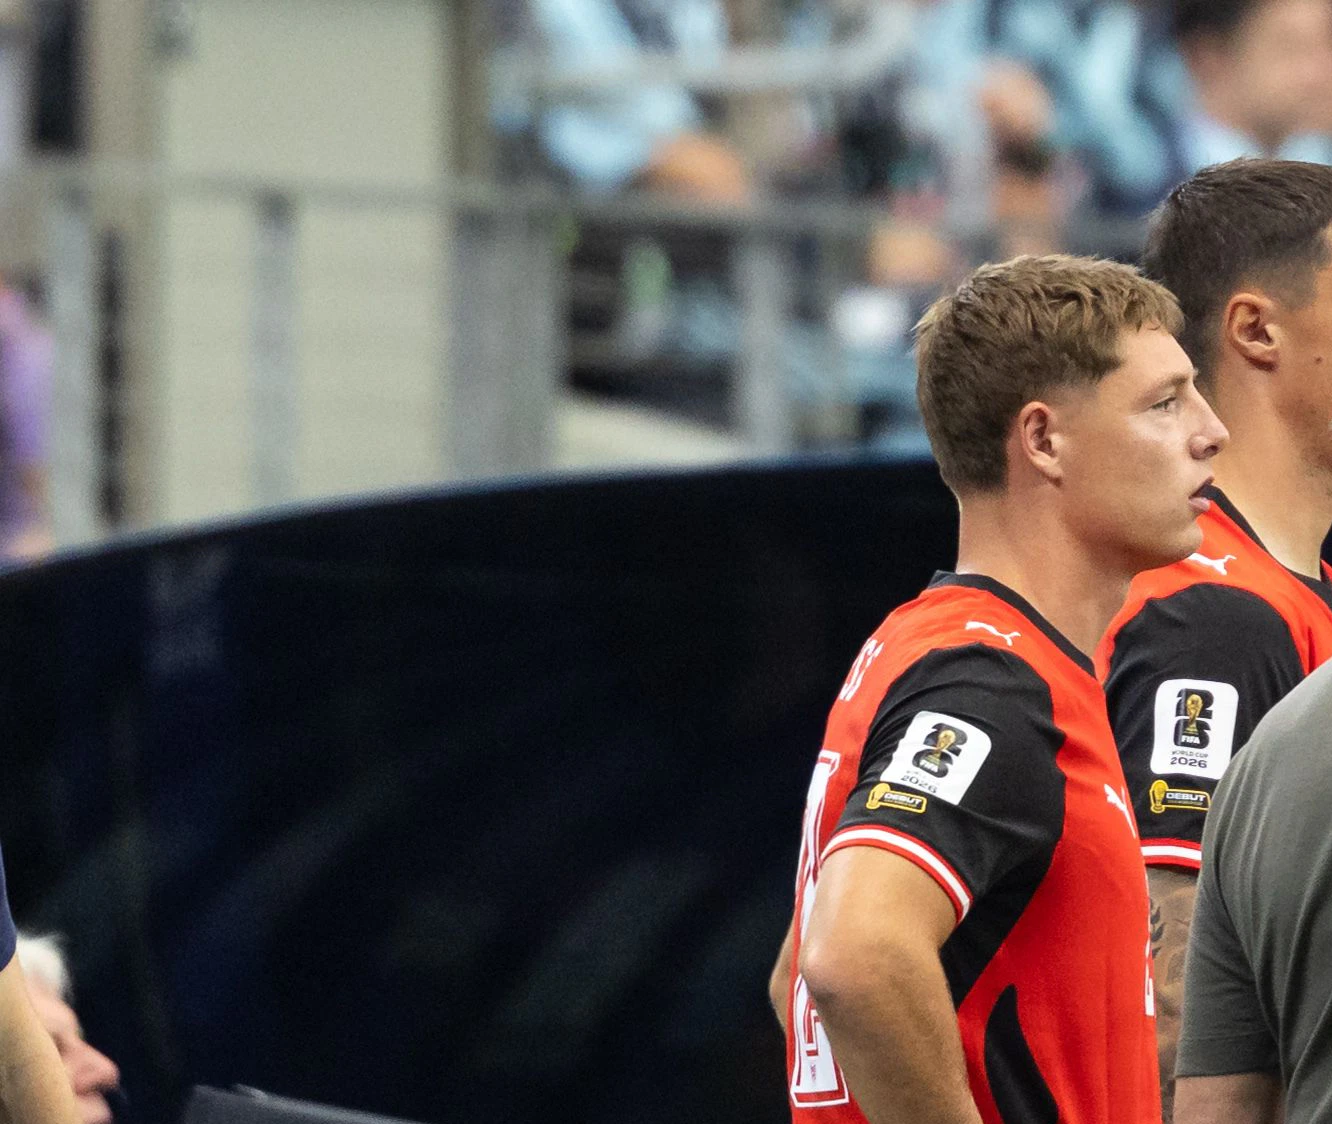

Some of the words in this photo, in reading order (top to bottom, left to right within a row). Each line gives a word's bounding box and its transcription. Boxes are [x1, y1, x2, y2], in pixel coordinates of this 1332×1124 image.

[1181, 735, 1200, 744] FIFA
[1170, 757, 1207, 768] 2026
[901, 775, 937, 794] 2026
[883, 792, 923, 805] DEBUT
[1166, 792, 1206, 801] DEBUT
